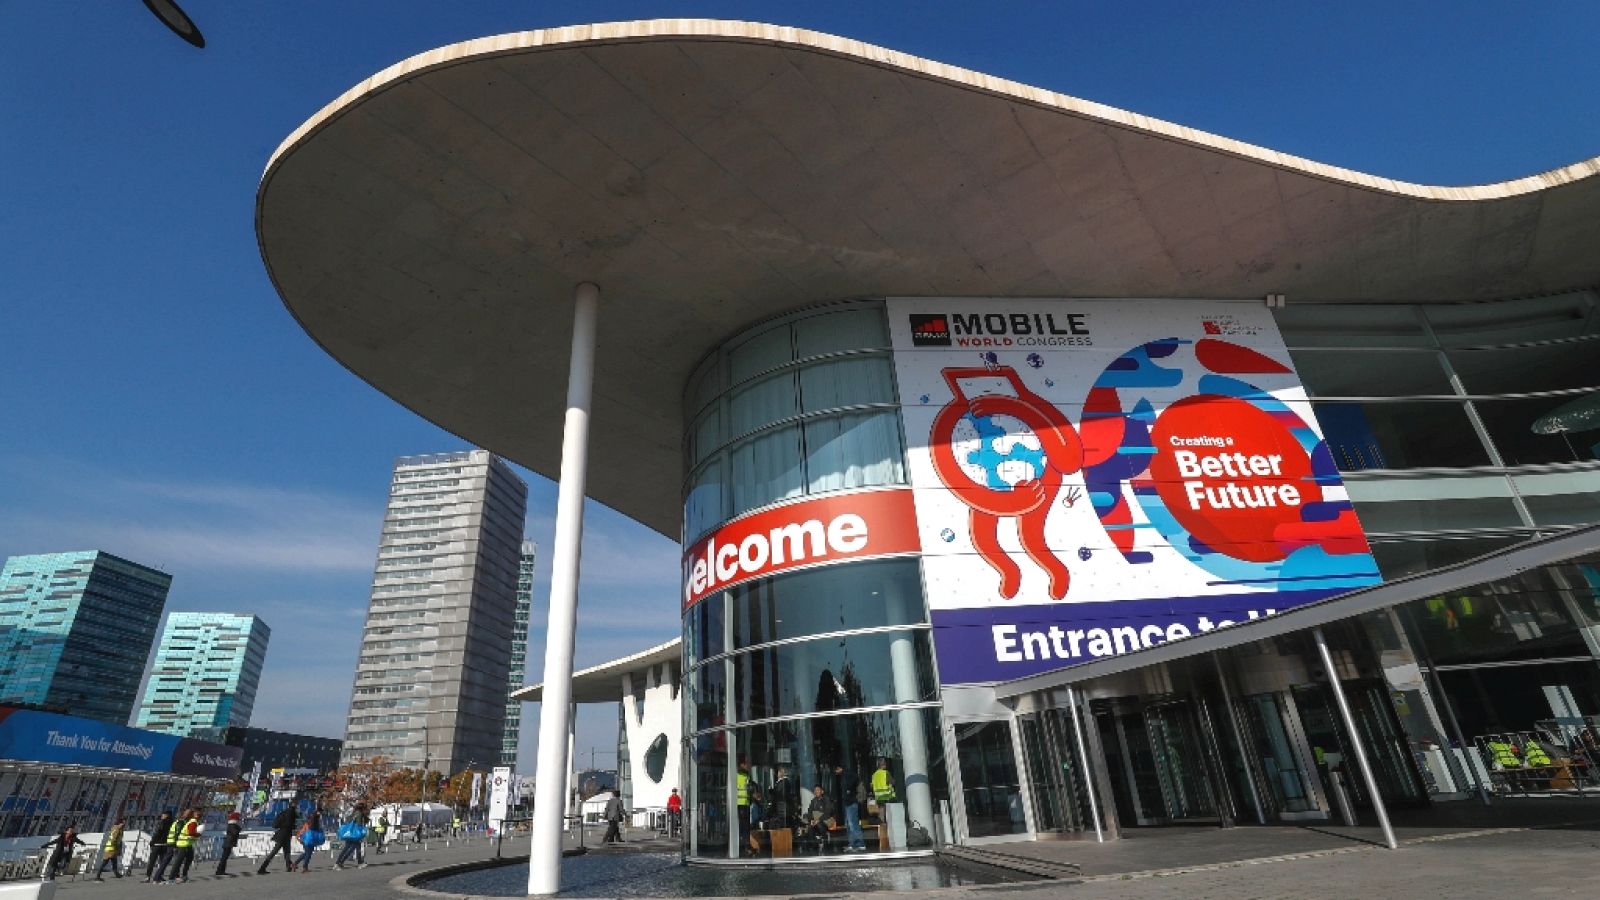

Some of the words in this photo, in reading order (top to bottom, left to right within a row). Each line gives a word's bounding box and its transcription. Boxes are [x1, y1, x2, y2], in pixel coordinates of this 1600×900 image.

[952, 313, 1090, 335] MOBILE
[956, 337, 1013, 347] WORLD
[1016, 337, 1093, 347] CONGRESS
[1170, 435, 1225, 447] Creating
[1226, 437, 1233, 446] a
[1174, 450, 1282, 478] Better
[1184, 480, 1300, 510] Future
[992, 623, 1191, 662] Entrance
[47, 730, 79, 748] Thank
[81, 735, 98, 751] You
[98, 737, 111, 752] for
